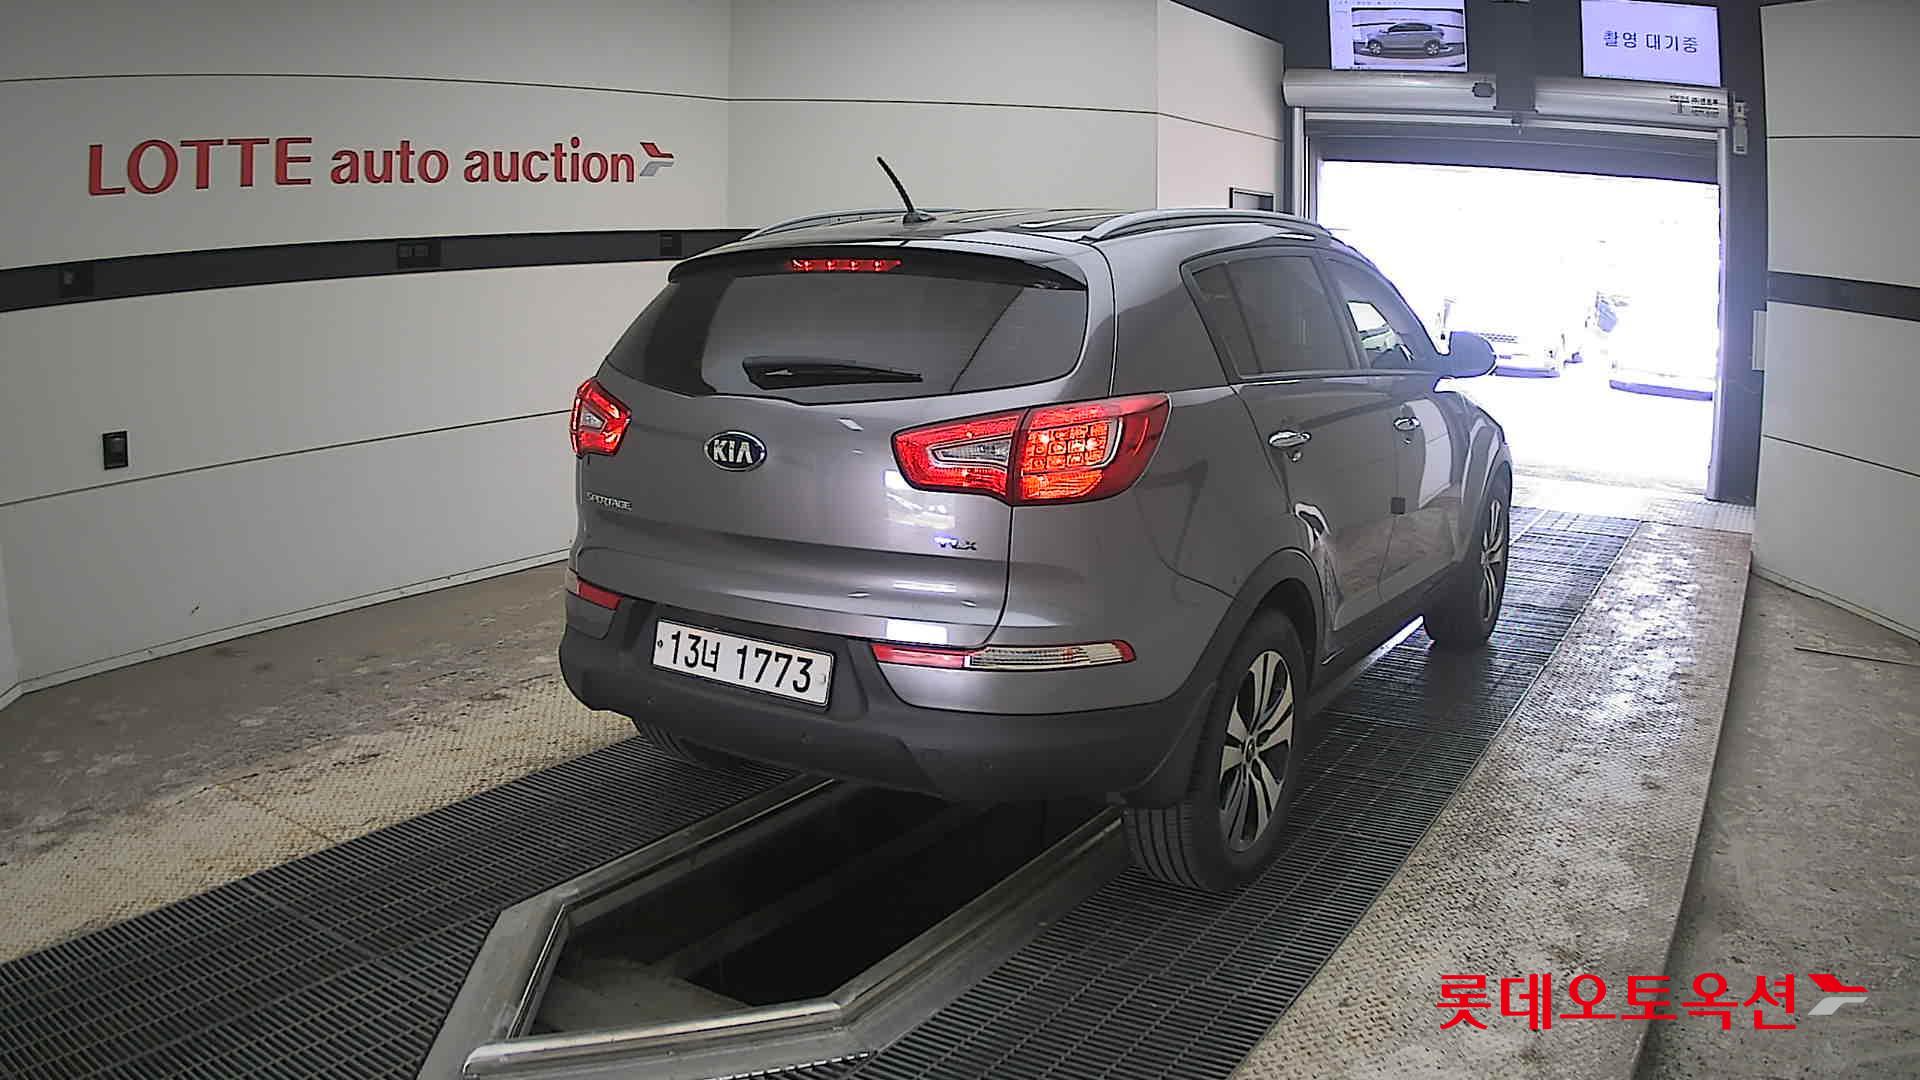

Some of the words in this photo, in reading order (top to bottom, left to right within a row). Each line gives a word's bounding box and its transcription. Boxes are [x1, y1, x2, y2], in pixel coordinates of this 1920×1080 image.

[1645, 33, 1698, 54] 대기중
[87, 136, 312, 197] LOTTE
[330, 140, 449, 185] auto
[463, 136, 635, 184] auction
[713, 439, 753, 464] KIA
[671, 630, 721, 673] 13너
[736, 644, 814, 693] 1773
